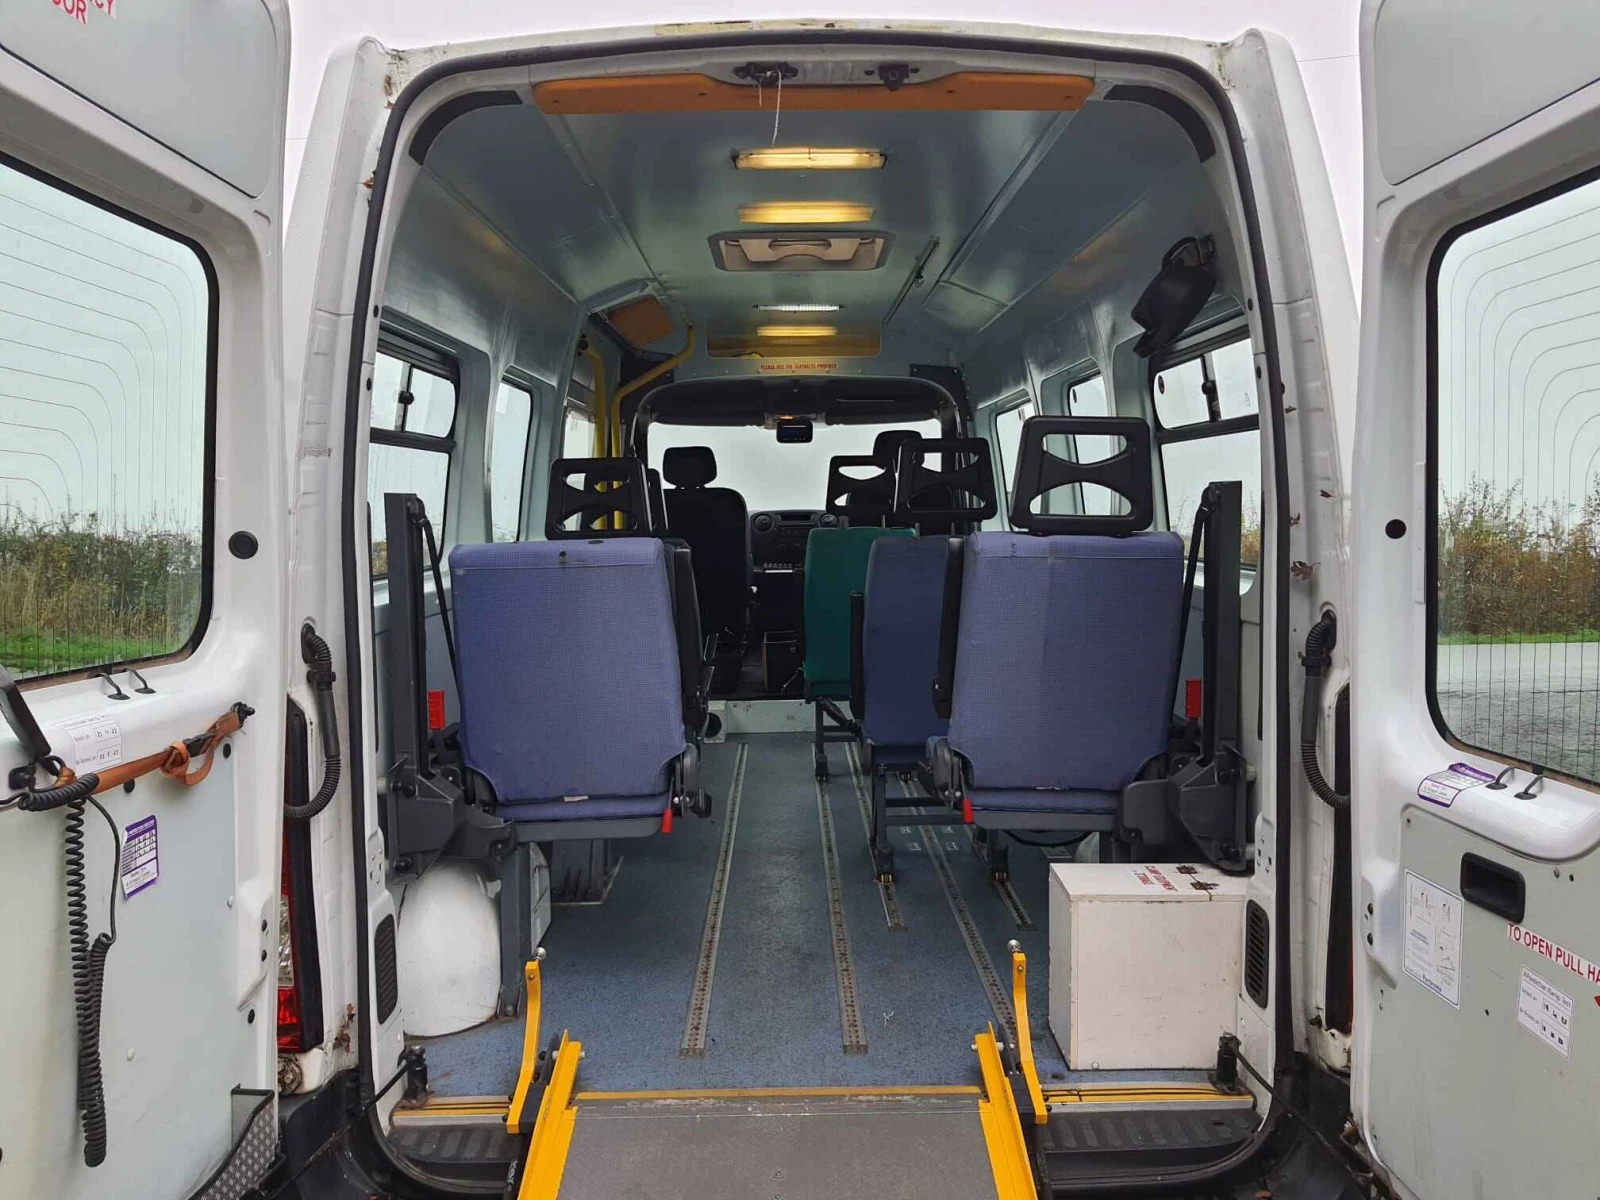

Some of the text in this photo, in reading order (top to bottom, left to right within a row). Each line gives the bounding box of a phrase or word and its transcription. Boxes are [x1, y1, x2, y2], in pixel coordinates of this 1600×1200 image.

[1507, 922, 1522, 942] TO
[1524, 931, 1553, 959] OPEN
[1555, 946, 1584, 976] PULL
